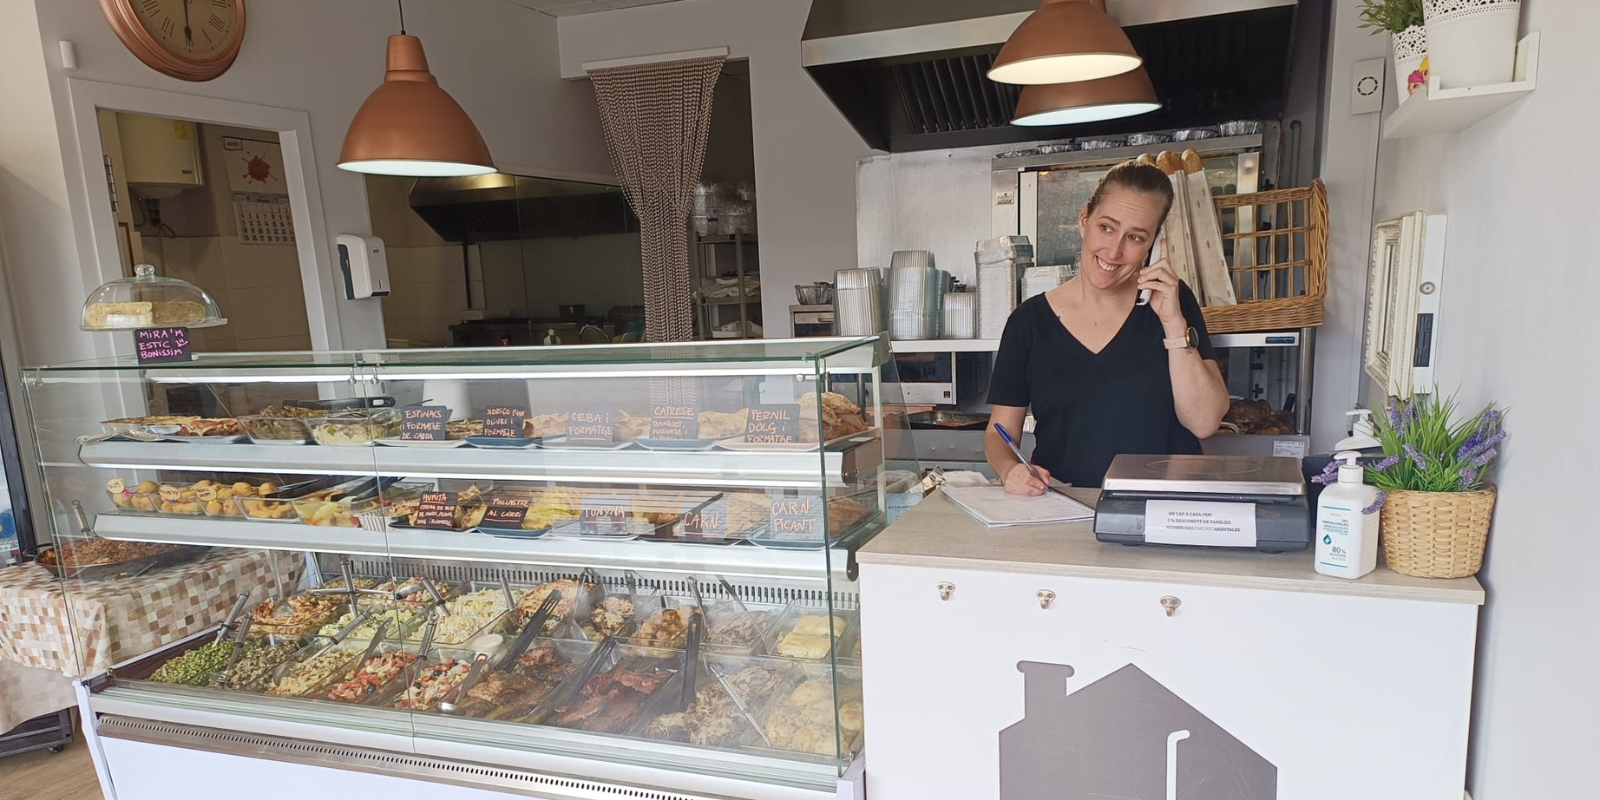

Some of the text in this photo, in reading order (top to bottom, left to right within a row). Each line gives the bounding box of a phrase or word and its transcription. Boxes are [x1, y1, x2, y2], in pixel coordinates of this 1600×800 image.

[654, 406, 695, 416] CAPRESE
[752, 410, 791, 420] PERNIL
[572, 413, 602, 423] CEBA
[569, 425, 613, 436] FORMATGE
[584, 506, 625, 518] TONYNA
[772, 498, 809, 516] CARN
[684, 511, 718, 529] CARN
[774, 518, 817, 532] PICANT
